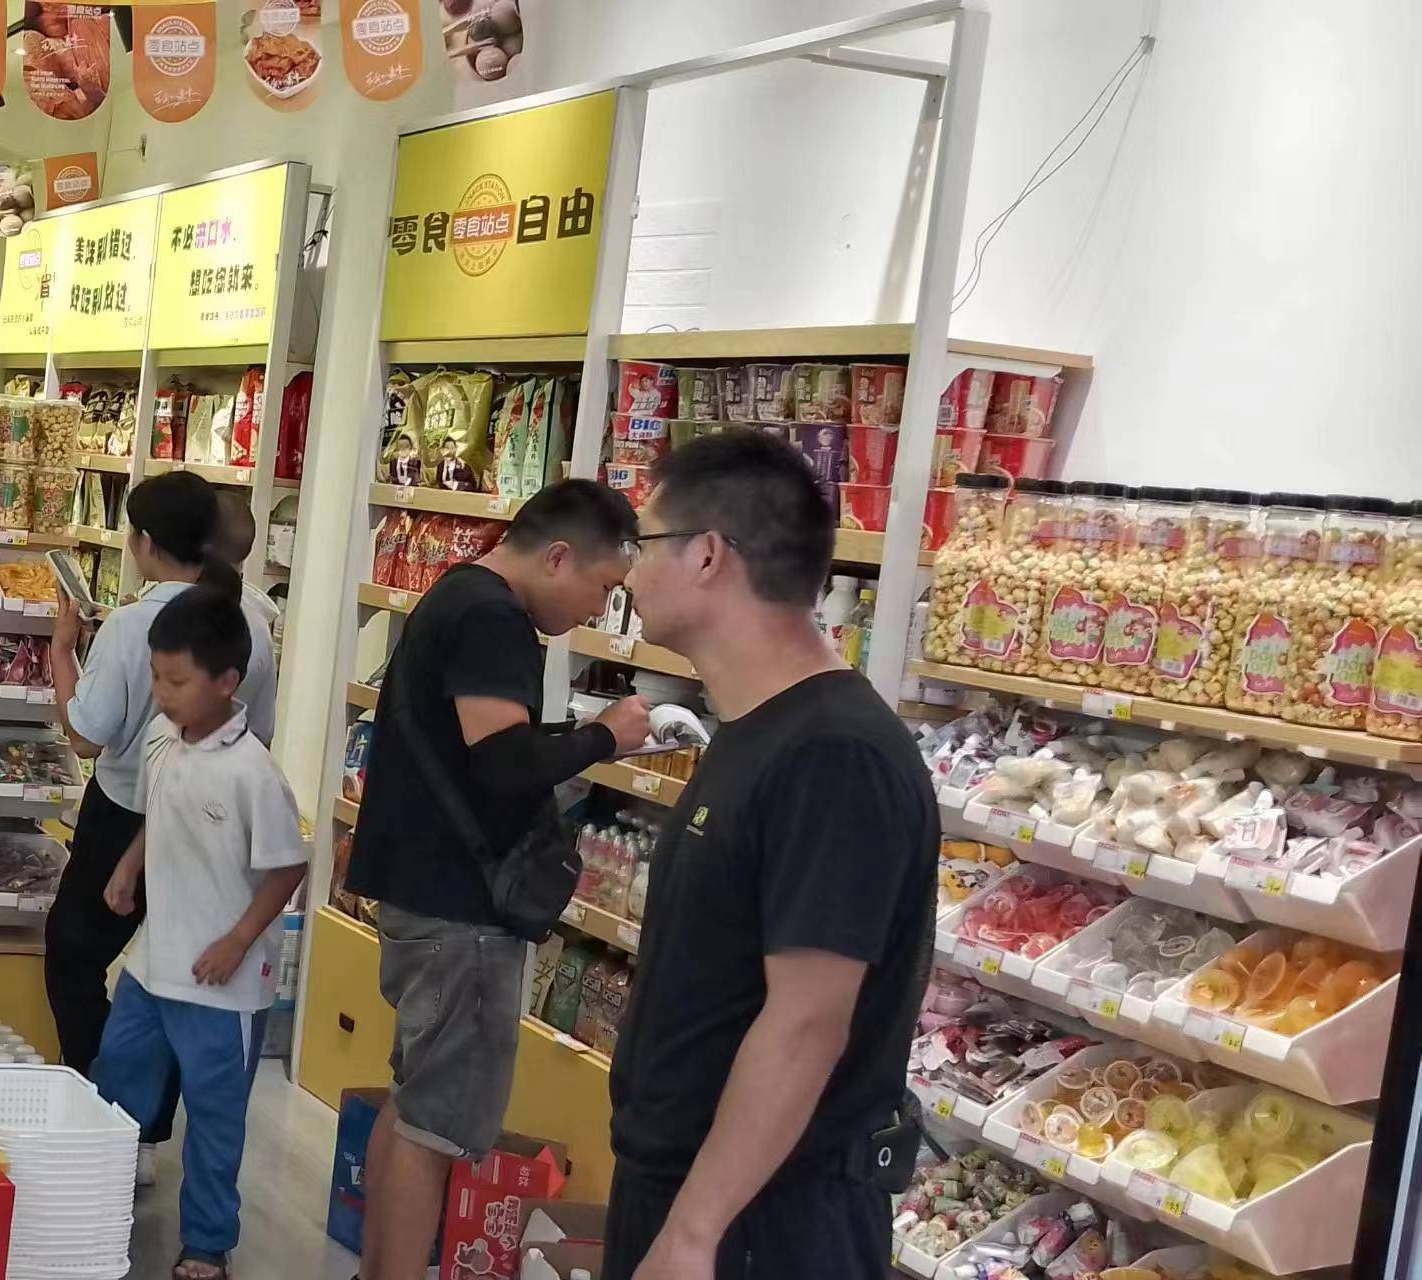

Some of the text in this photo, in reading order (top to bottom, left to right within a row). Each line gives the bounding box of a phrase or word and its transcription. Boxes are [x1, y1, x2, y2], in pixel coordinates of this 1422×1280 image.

[387, 187, 594, 256] 零食 零食站点 自由
